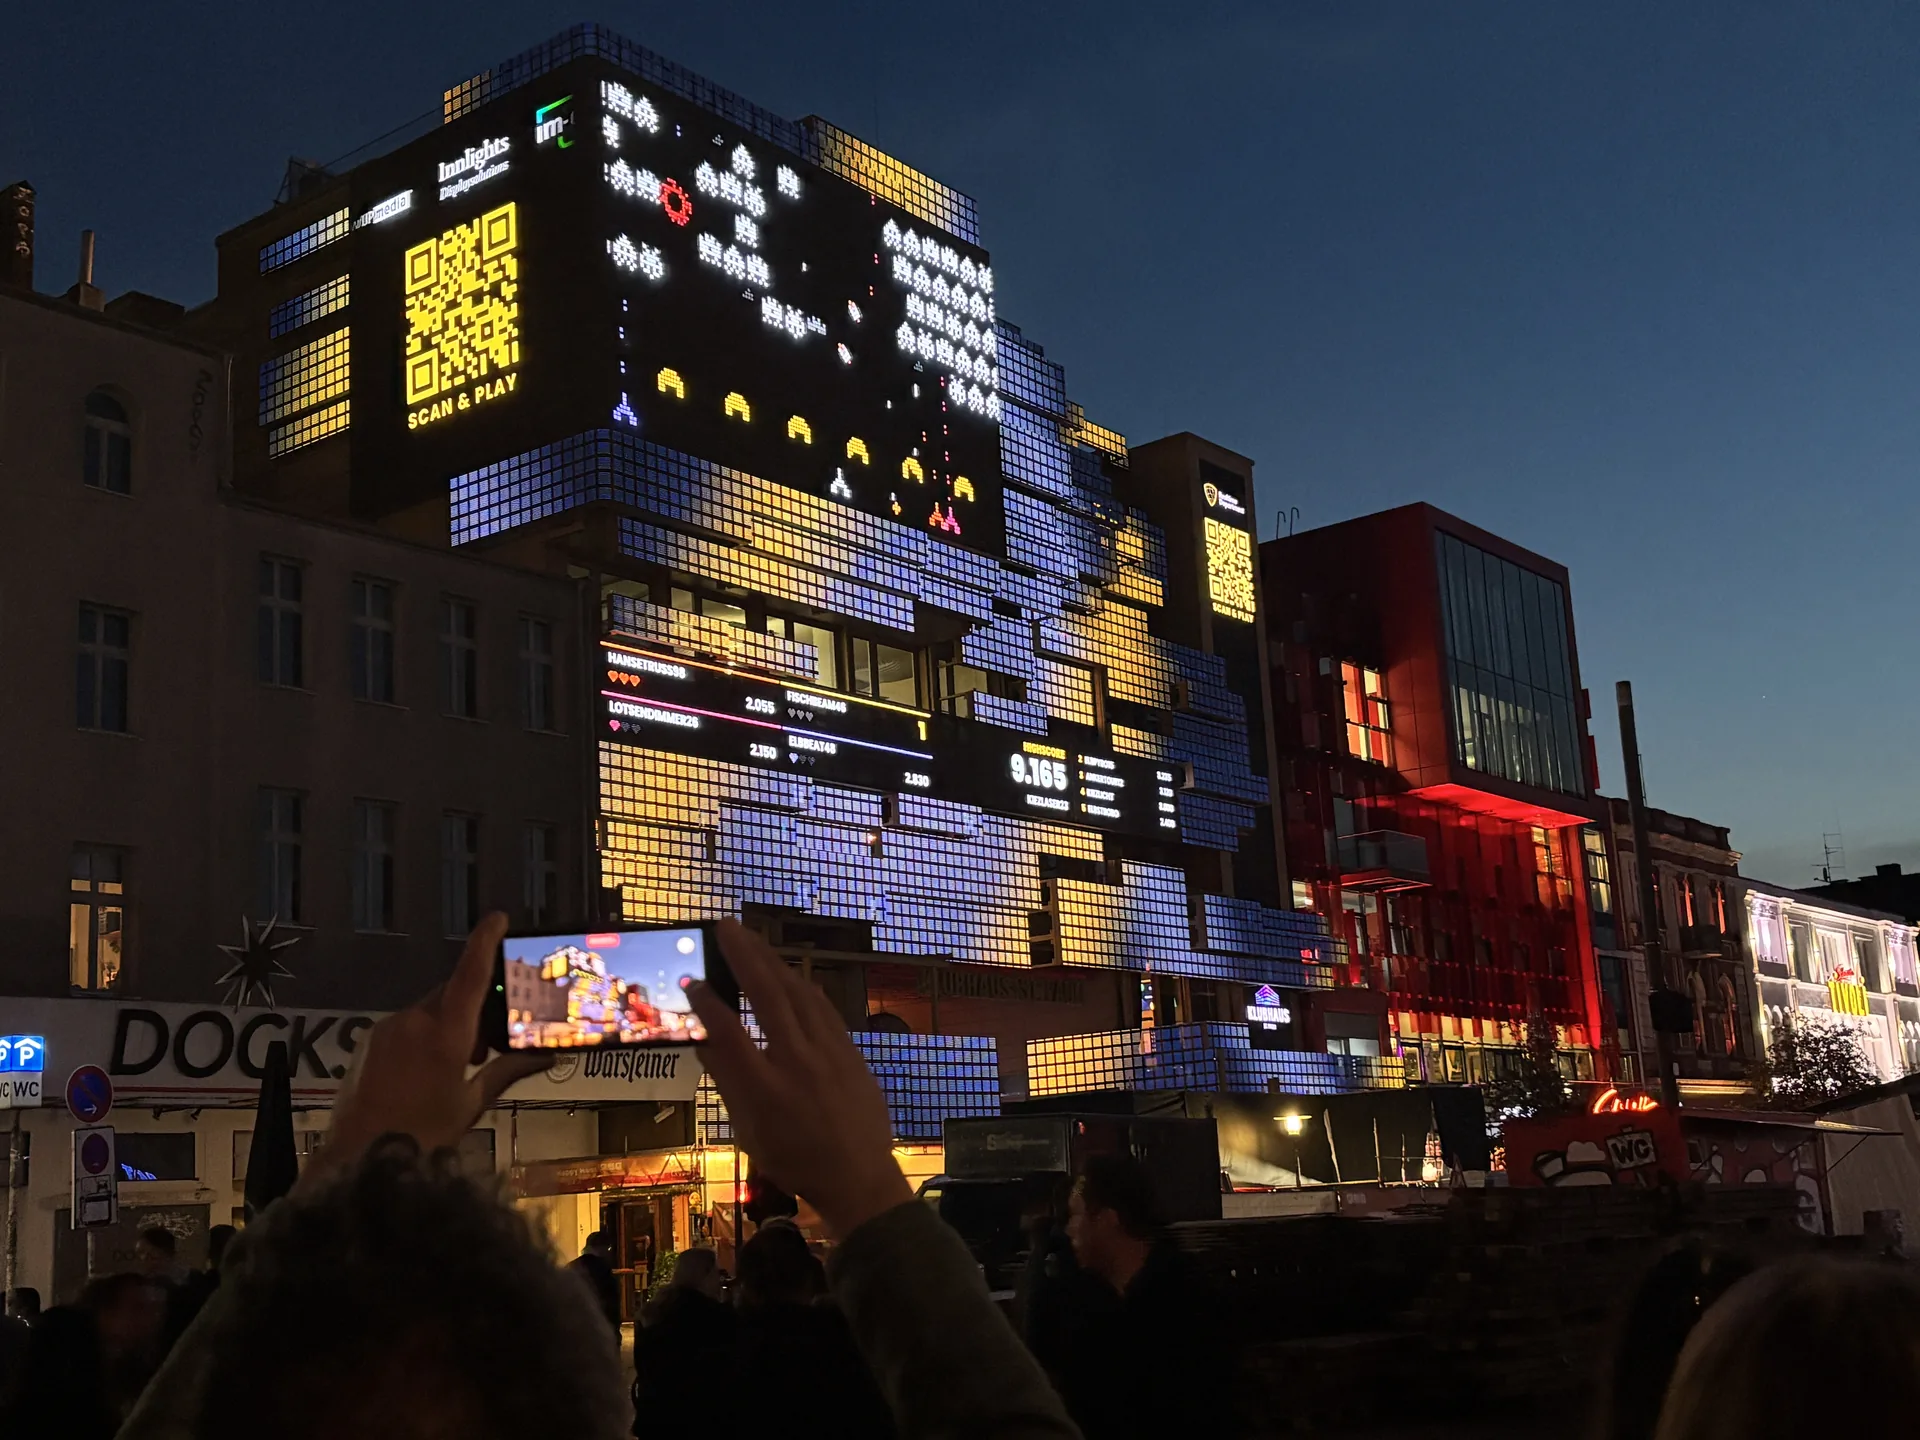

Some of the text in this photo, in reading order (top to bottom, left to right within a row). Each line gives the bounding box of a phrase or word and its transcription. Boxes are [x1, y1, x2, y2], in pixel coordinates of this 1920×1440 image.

[438, 136, 511, 182] Innlights
[408, 372, 517, 429] SCAN & PLAY
[607, 651, 686, 679] HANSETRUSS98
[745, 696, 775, 714] 2.055
[917, 720, 927, 741] 1
[1010, 753, 1068, 791] 9.165
[1246, 1006, 1291, 1024] KLUBHAUS
[20, 1046, 35, 1067] P
[13, 1081, 39, 1097] WC
[1611, 1139, 1650, 1164] WC
